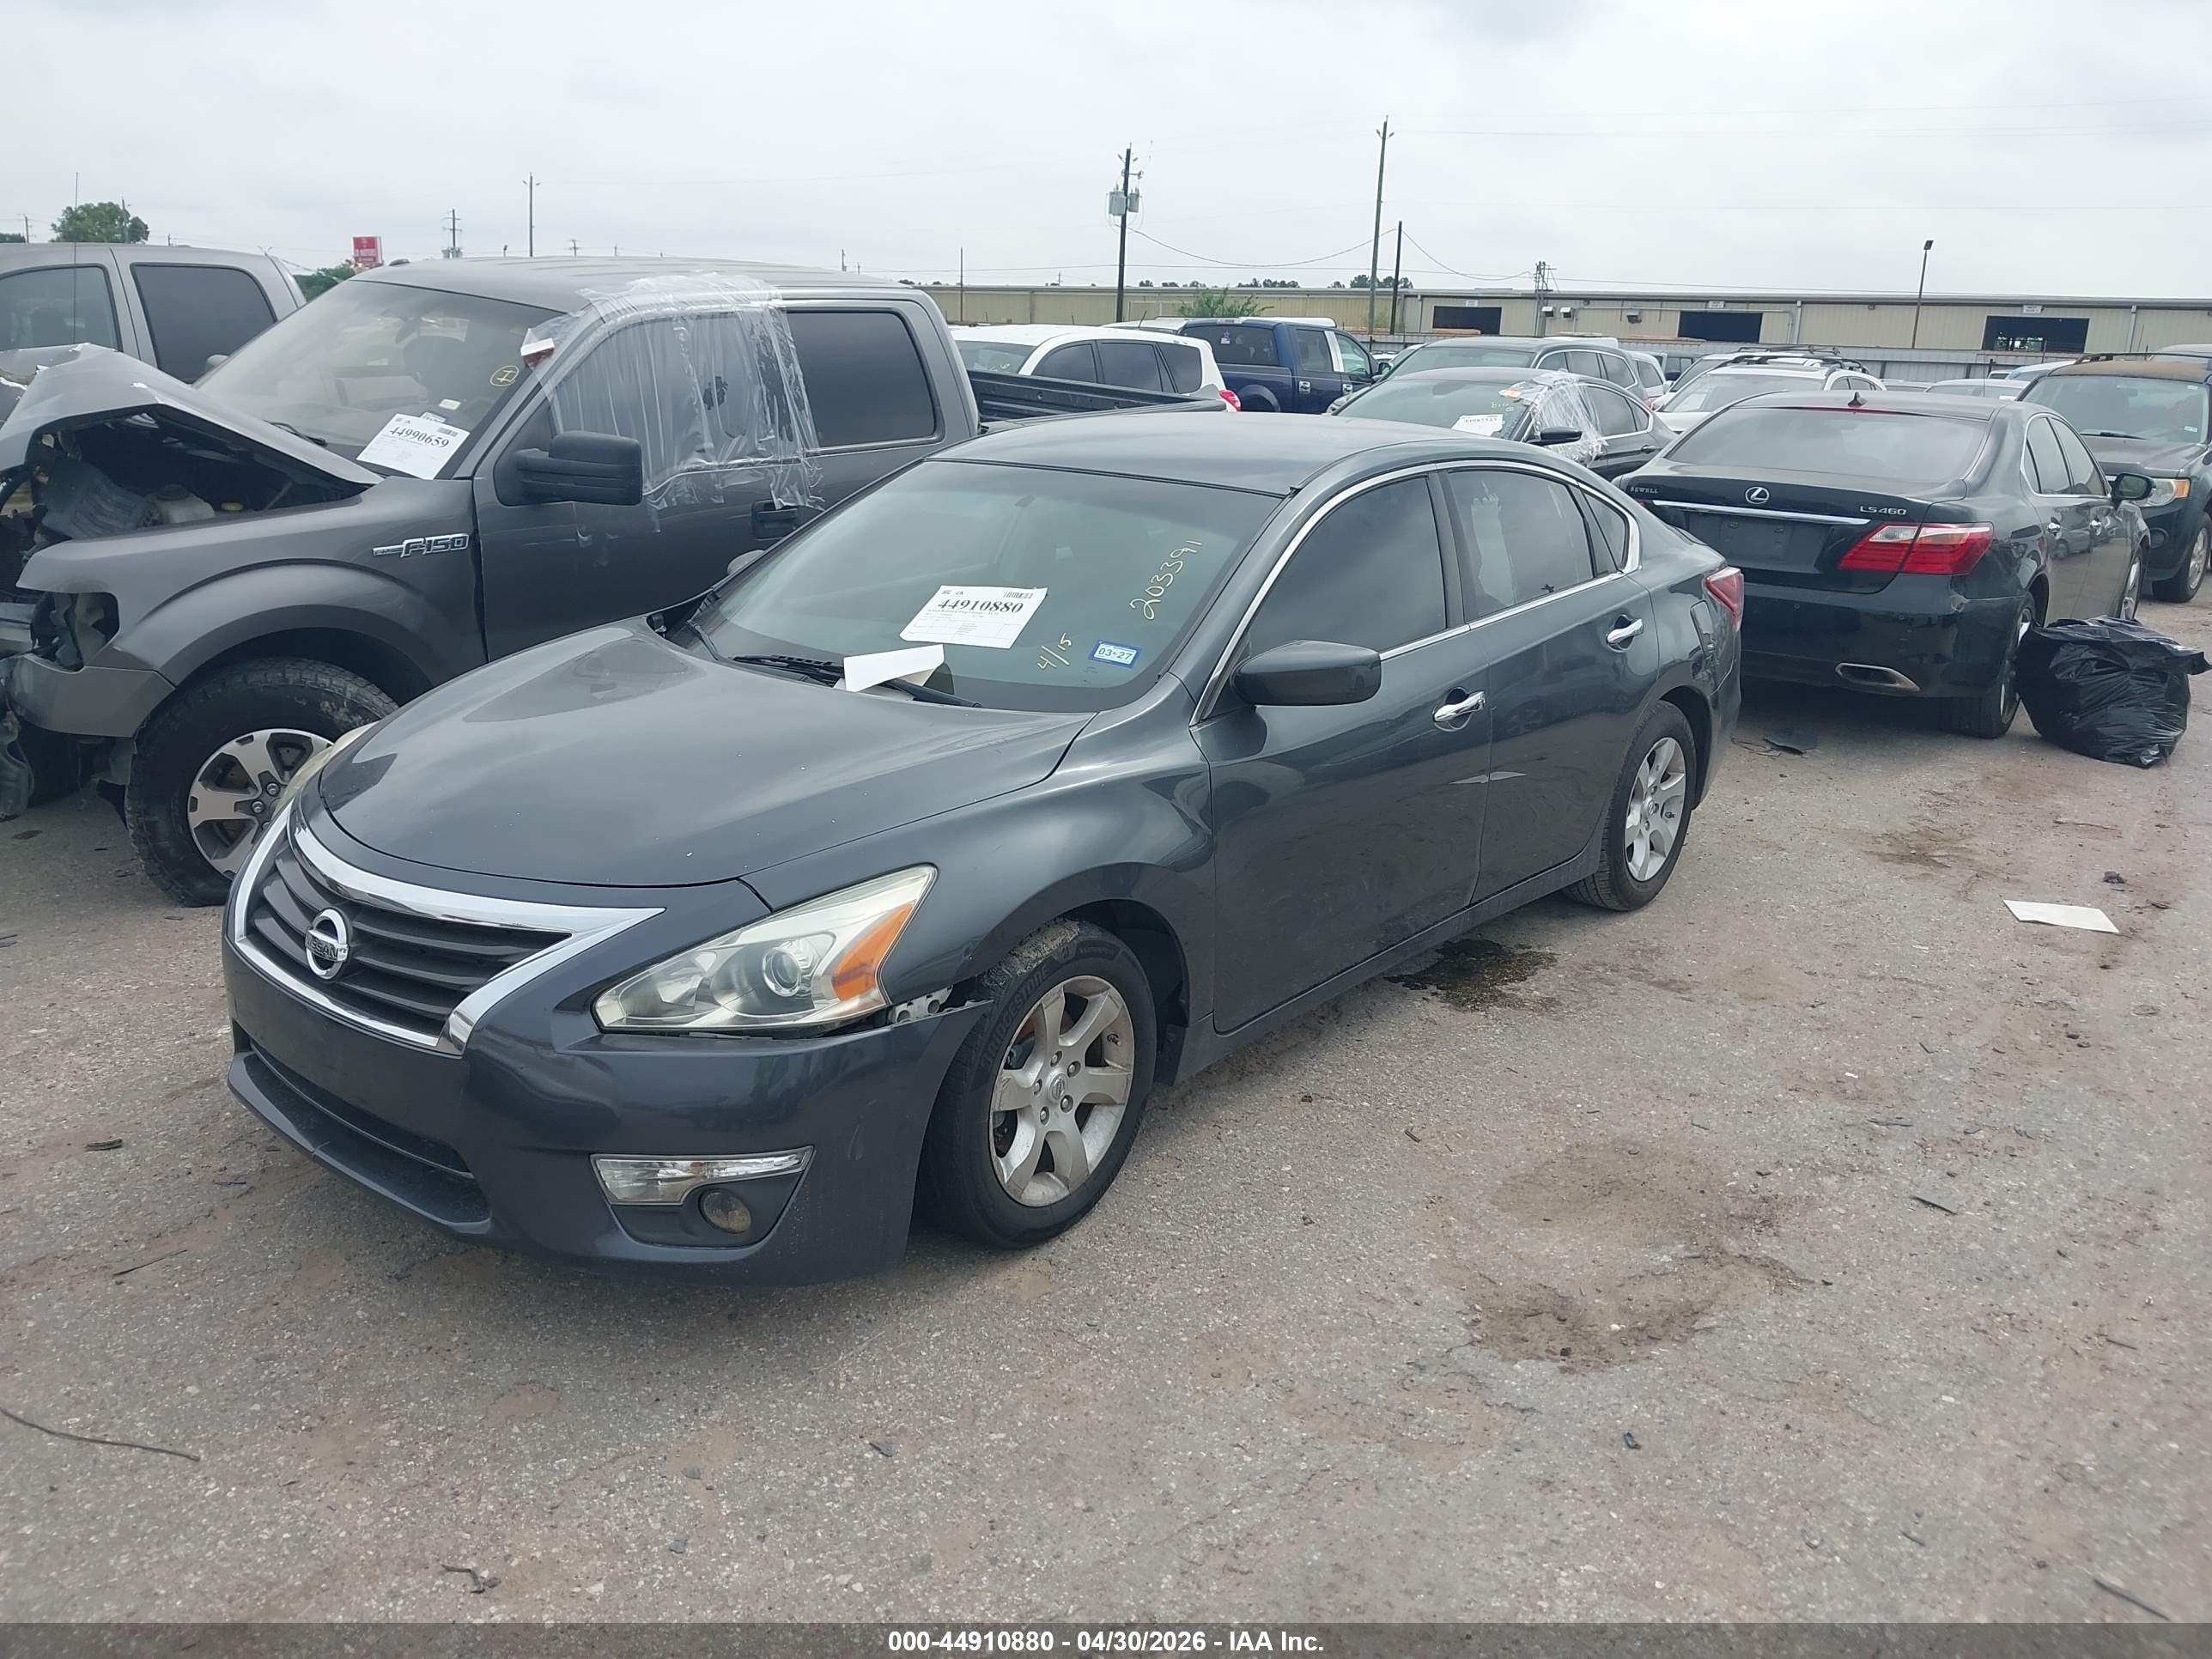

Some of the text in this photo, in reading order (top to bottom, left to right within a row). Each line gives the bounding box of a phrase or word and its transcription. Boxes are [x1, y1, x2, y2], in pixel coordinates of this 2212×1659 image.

[389, 426, 450, 447] 44990659
[938, 599, 1024, 614] 44910880
[306, 931, 339, 961] NISSAN
